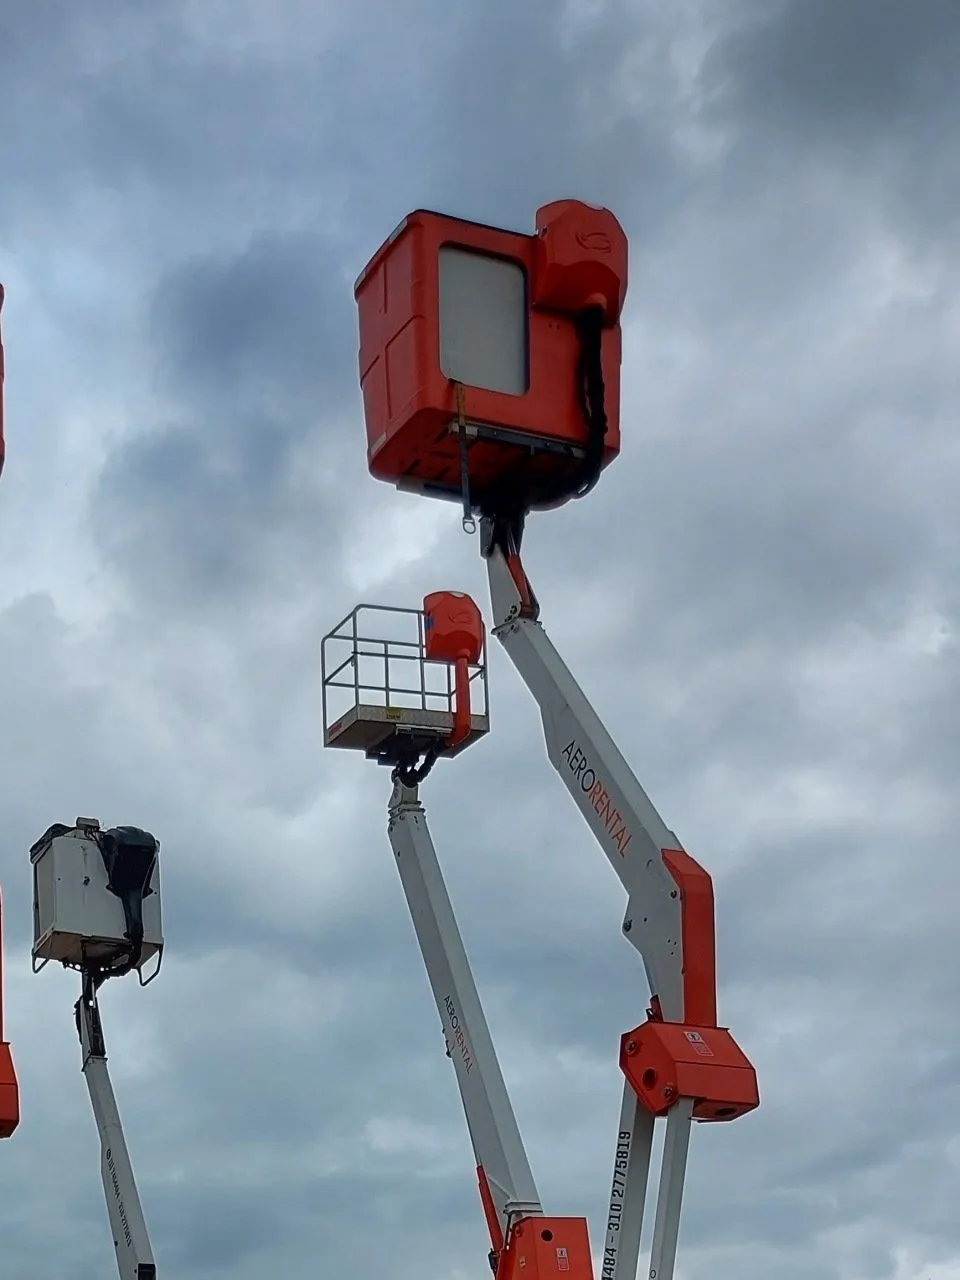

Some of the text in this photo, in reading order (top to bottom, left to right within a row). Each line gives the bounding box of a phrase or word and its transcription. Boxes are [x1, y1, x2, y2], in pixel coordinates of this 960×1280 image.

[561, 740, 632, 858] AERORENTAL
[443, 994, 473, 1075] AERORENTAL
[612, 1130, 631, 1198] 2775819
[607, 1203, 622, 1232] 310
